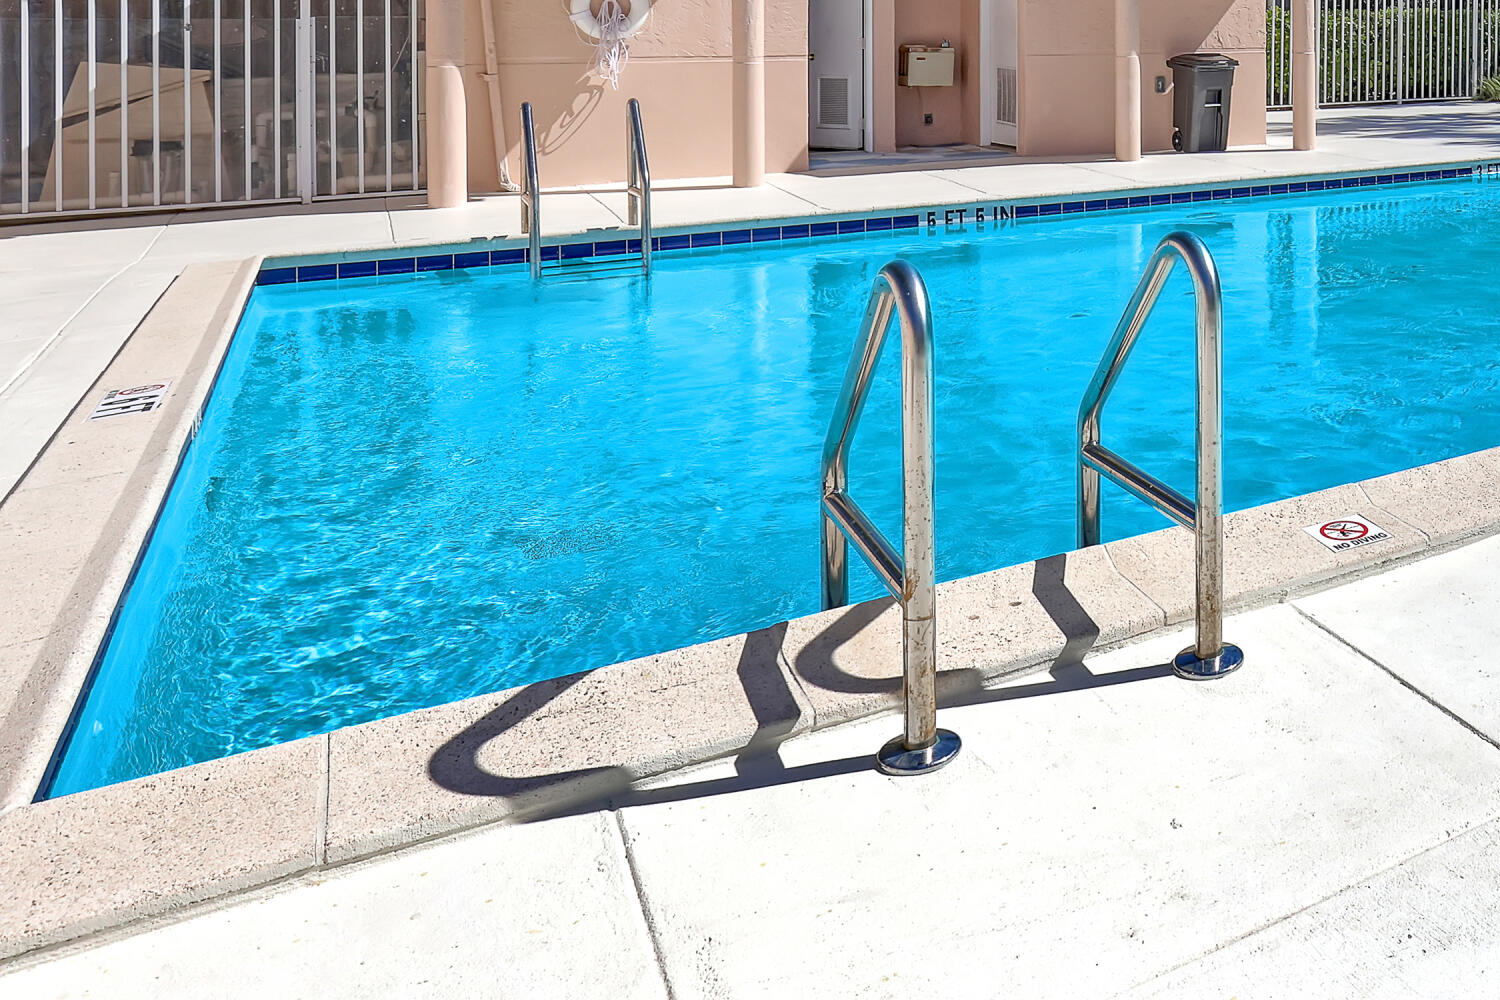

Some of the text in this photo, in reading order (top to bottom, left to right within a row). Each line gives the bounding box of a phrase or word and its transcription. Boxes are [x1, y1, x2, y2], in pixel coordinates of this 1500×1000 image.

[944, 208, 967, 225] FT
[993, 205, 1015, 221] IN
[1333, 532, 1388, 551] NO DIVING
